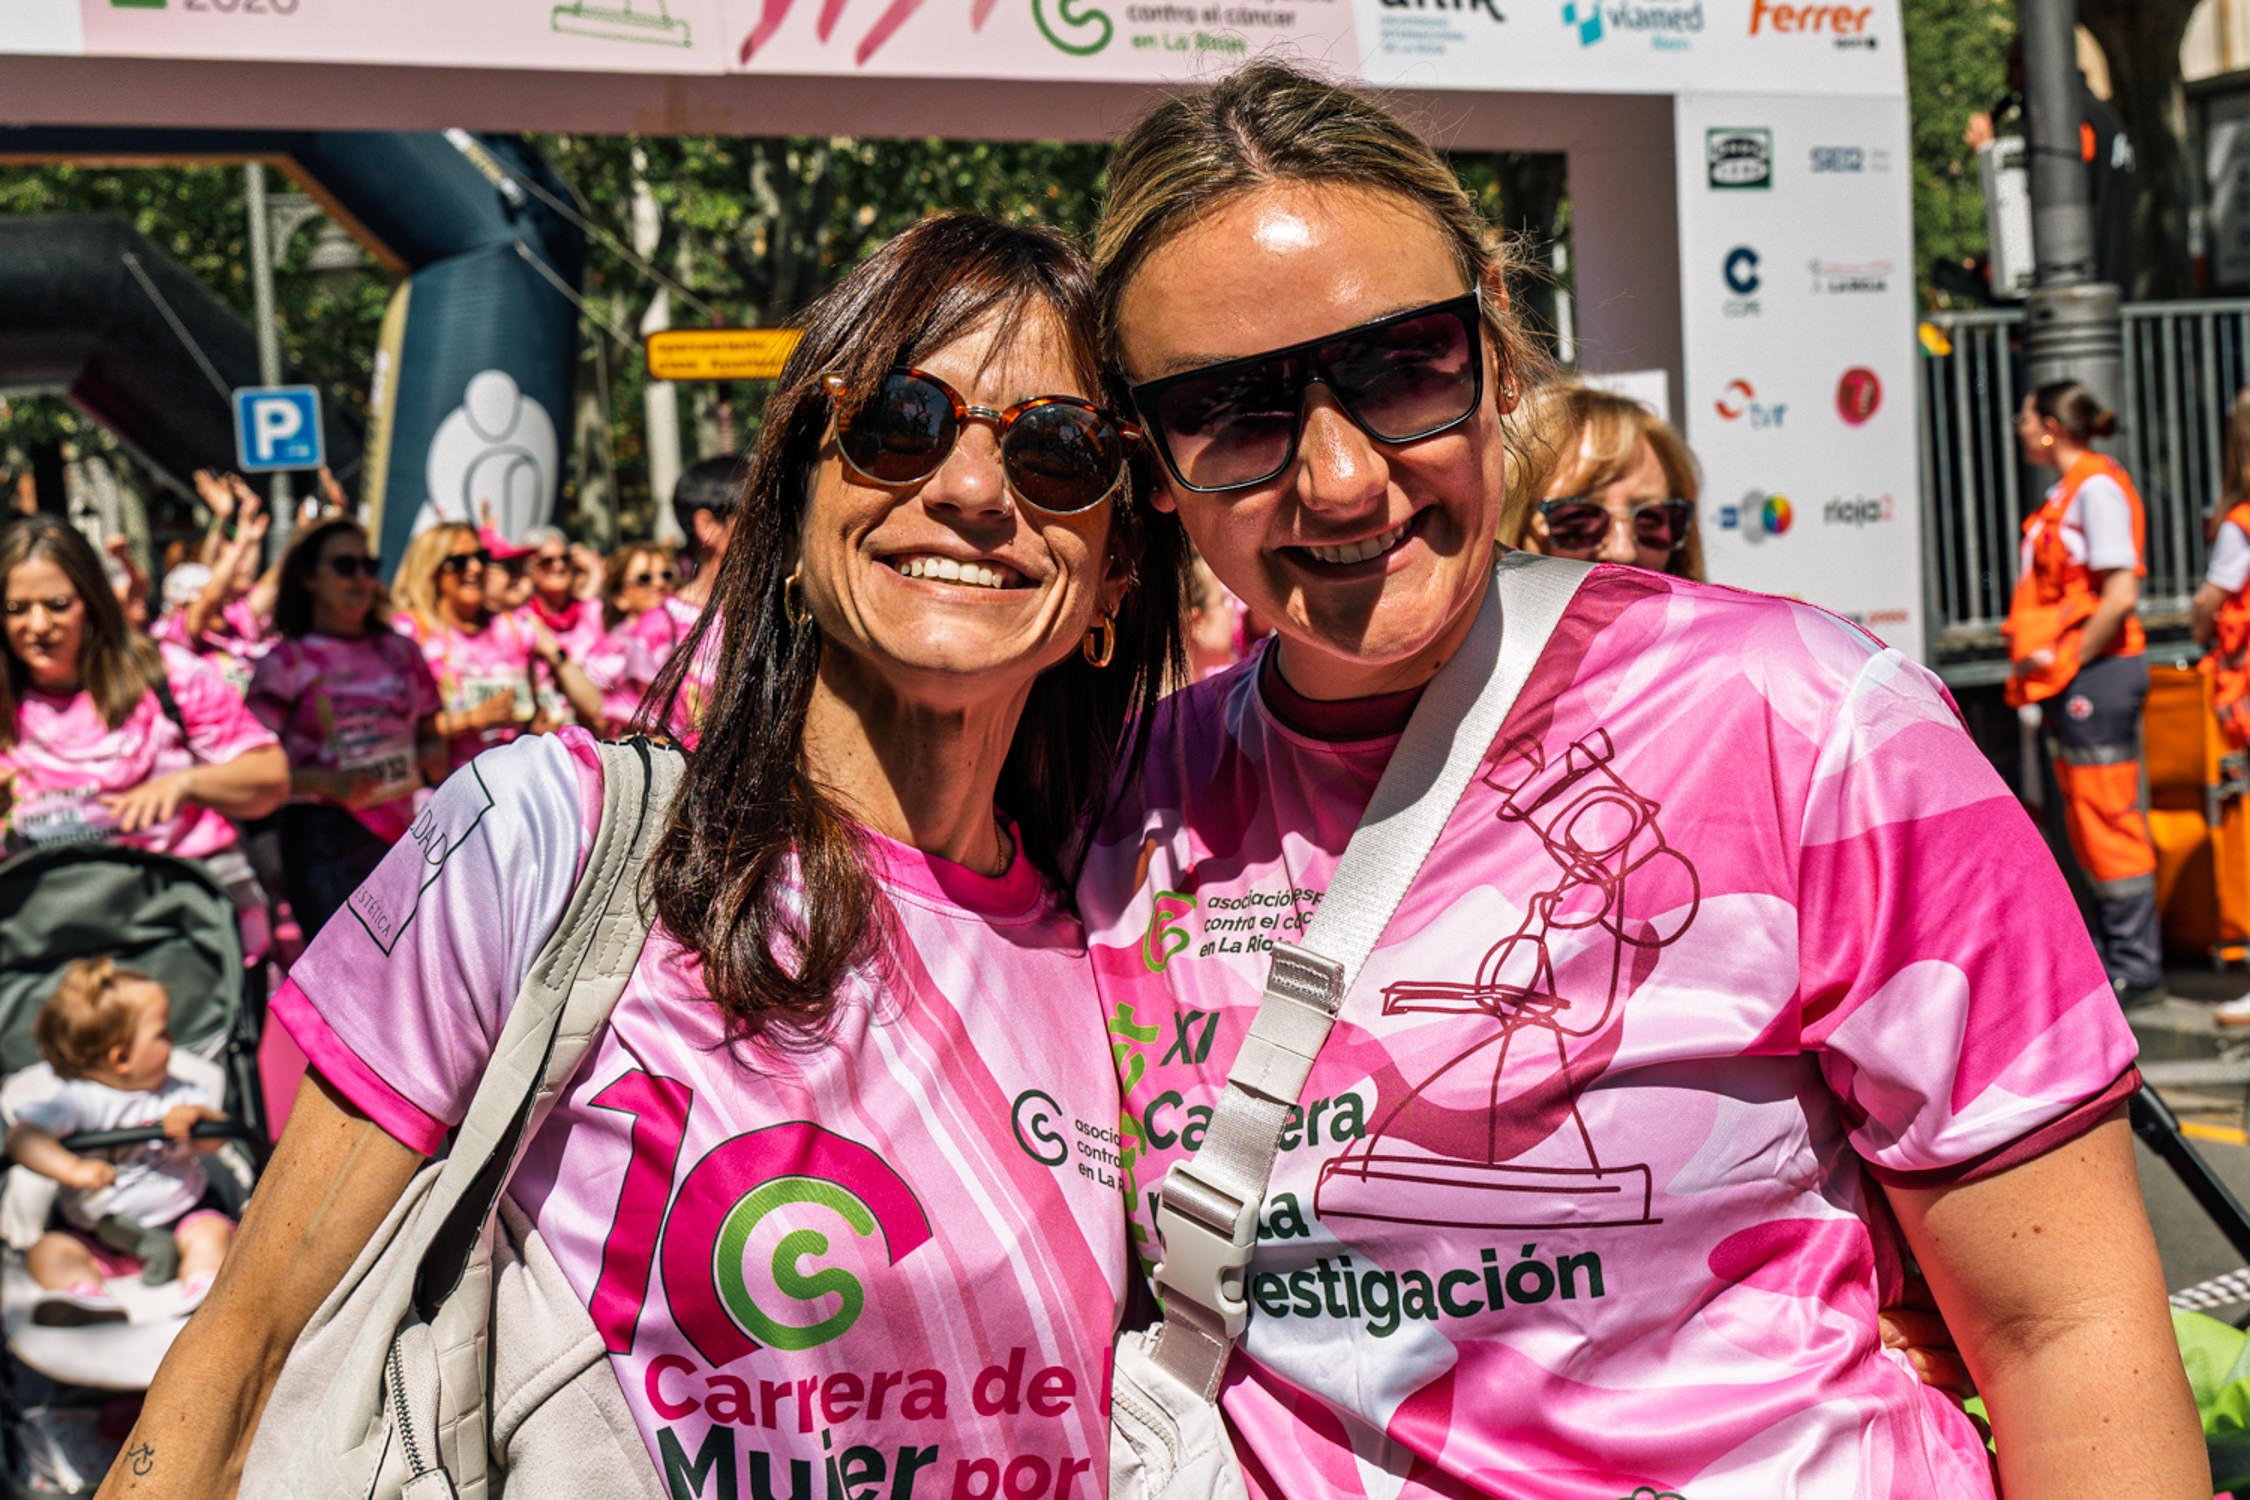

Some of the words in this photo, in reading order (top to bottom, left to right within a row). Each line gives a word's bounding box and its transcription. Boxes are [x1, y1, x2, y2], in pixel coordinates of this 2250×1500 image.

[254, 399, 303, 461] P
[409, 807, 448, 865] DAD
[1199, 941, 1216, 957] en
[1218, 936, 1243, 953] La
[1204, 914, 1256, 933] contra
[1260, 913, 1280, 930] el
[1159, 1010, 1220, 1067] XI
[1143, 1090, 1366, 1152] Caera
[1078, 1162, 1094, 1180] en
[1098, 1168, 1115, 1189] La
[1253, 1243, 1605, 1339] estigación
[645, 1354, 948, 1434] Carrera
[972, 1347, 1077, 1418] de
[656, 1423, 940, 1500] Mujer
[951, 1454, 1091, 1500] por
